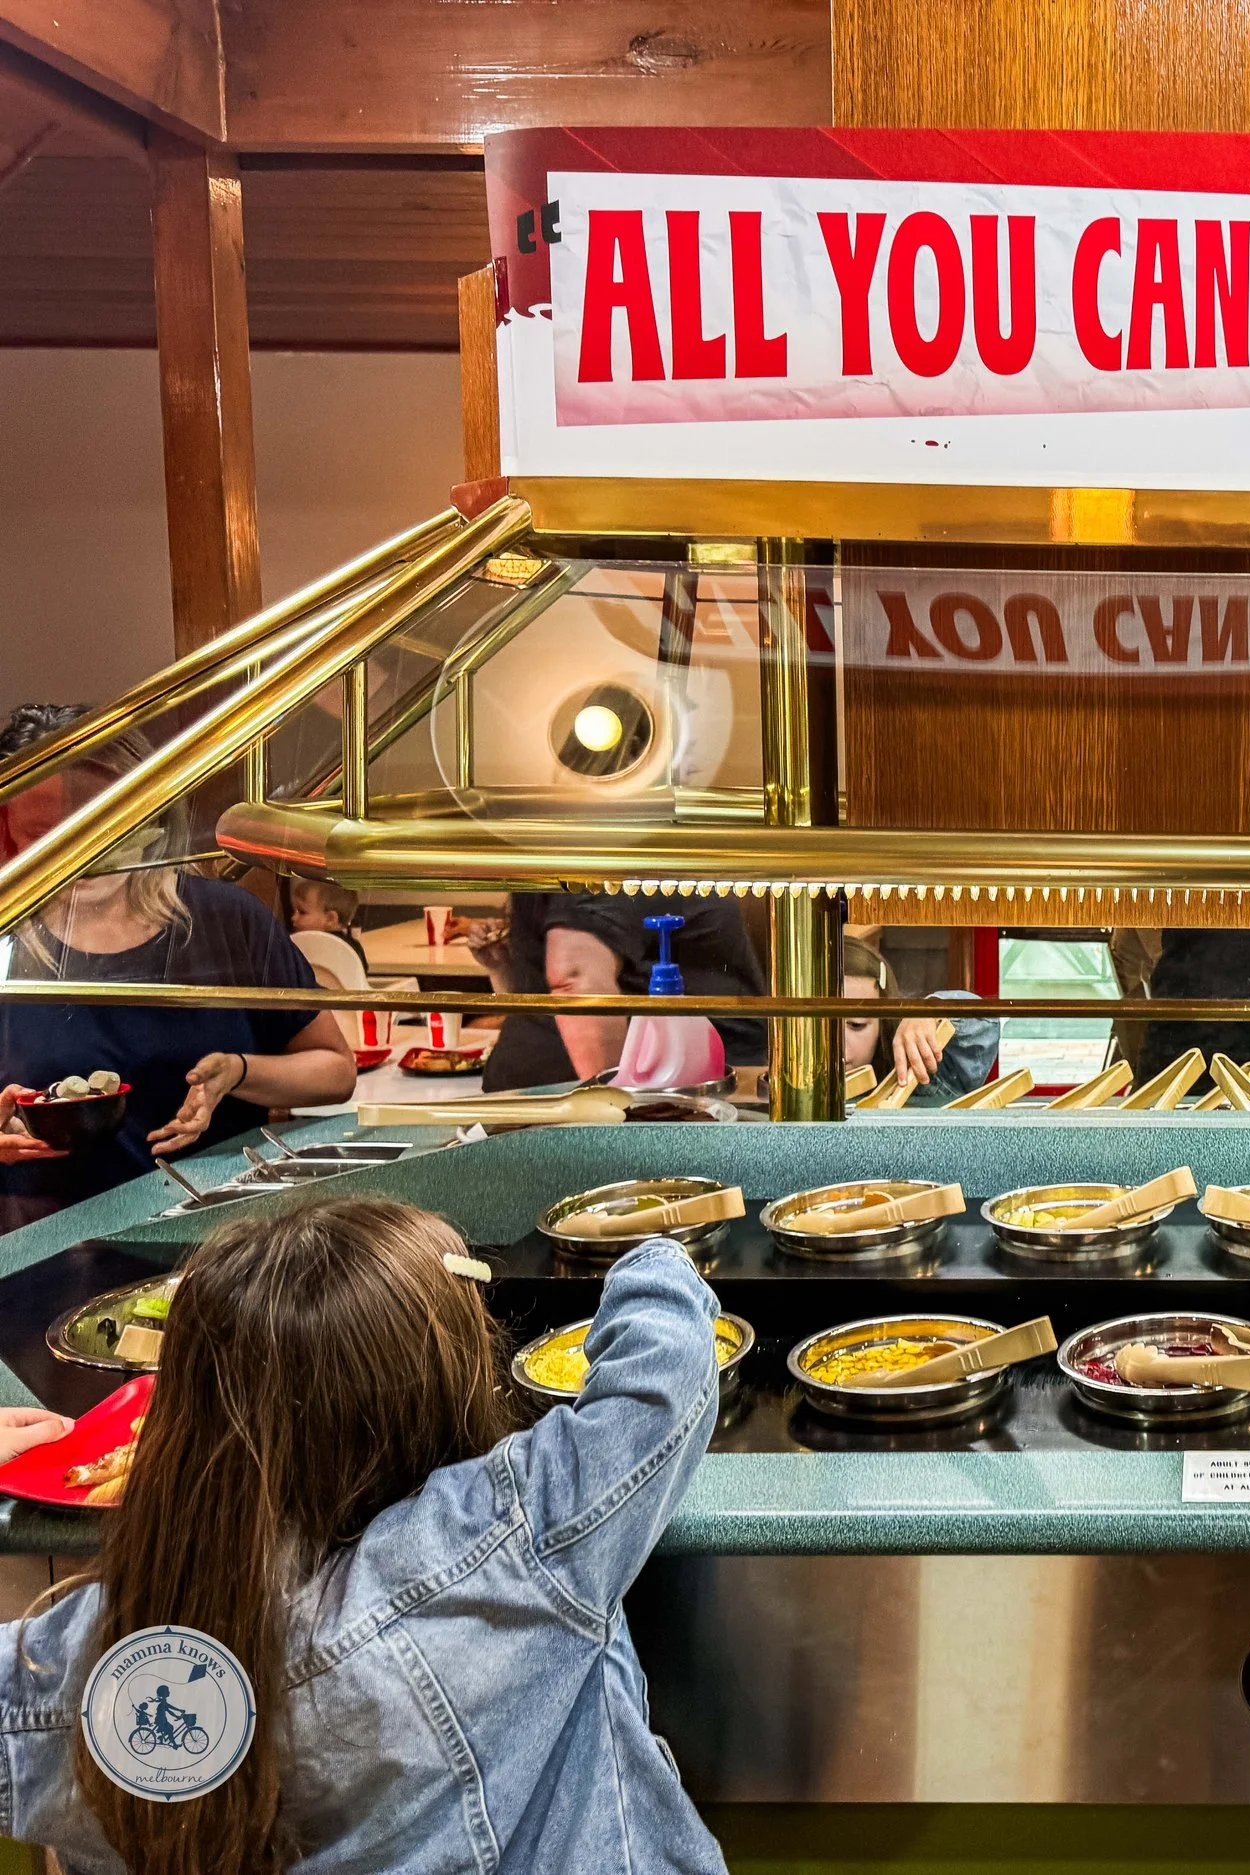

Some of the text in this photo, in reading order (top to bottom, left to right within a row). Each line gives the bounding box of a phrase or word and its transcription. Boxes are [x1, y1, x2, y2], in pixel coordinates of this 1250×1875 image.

[817, 210, 1037, 378] YOU
[1210, 1460, 1239, 1468] ADULT
[1223, 1483, 1235, 1491] AT
